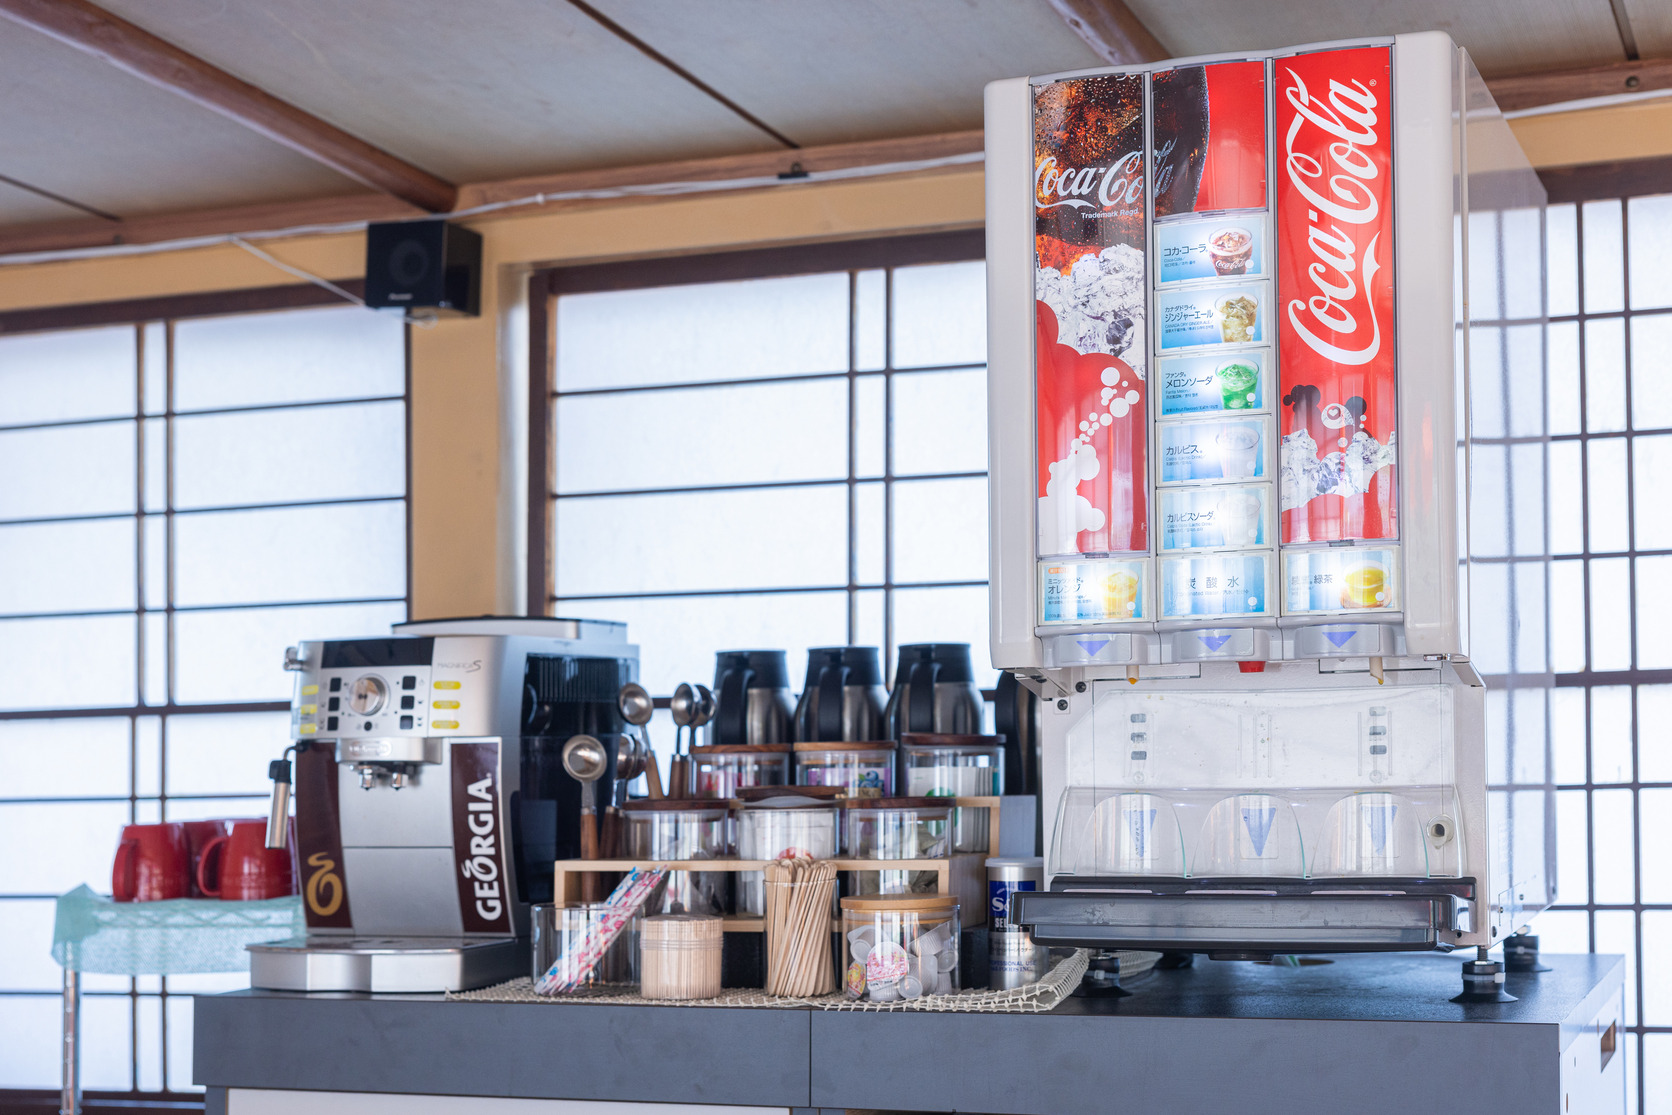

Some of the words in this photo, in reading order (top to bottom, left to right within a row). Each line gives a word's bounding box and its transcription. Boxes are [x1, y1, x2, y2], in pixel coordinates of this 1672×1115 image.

[1081, 211, 1118, 220] Trademark
[1285, 66, 1382, 365] Coca-Cola
[1165, 309, 1214, 323] ジンジャーエール
[1165, 375, 1214, 389] メロンソーダ
[1166, 444, 1199, 456] カルピス
[1167, 510, 1214, 523] カルピスソーダ
[462, 774, 502, 921] GEORGIA
